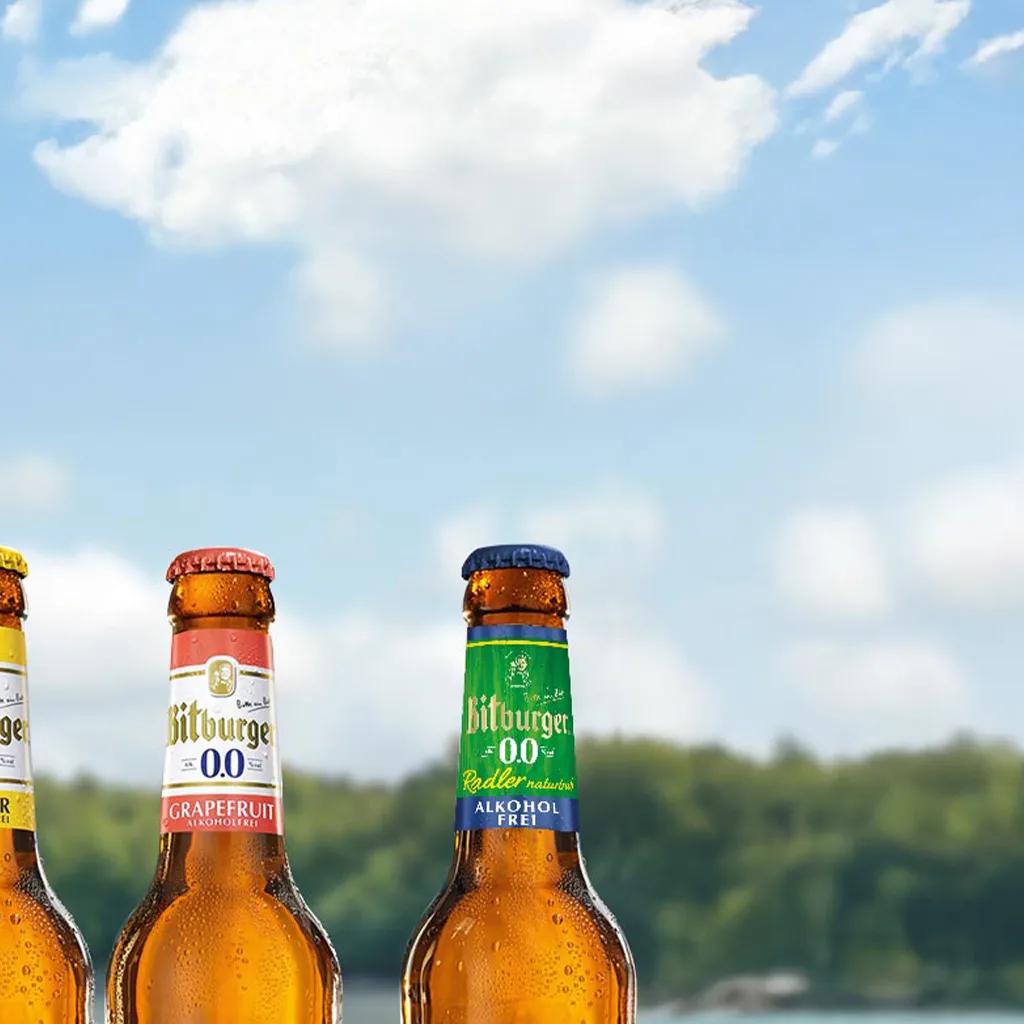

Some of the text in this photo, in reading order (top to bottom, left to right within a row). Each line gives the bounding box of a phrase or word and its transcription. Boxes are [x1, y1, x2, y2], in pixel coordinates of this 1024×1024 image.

[466, 694, 568, 739] Bitburger
[499, 737, 538, 764] 0.0
[200, 748, 244, 778] 0.0
[463, 767, 526, 794] Radler
[169, 799, 274, 820] GRAPEFRUIT
[475, 800, 559, 814] ALKOHOL
[187, 818, 258, 828] ALKOHOLFREI
[498, 814, 536, 826] FREI
